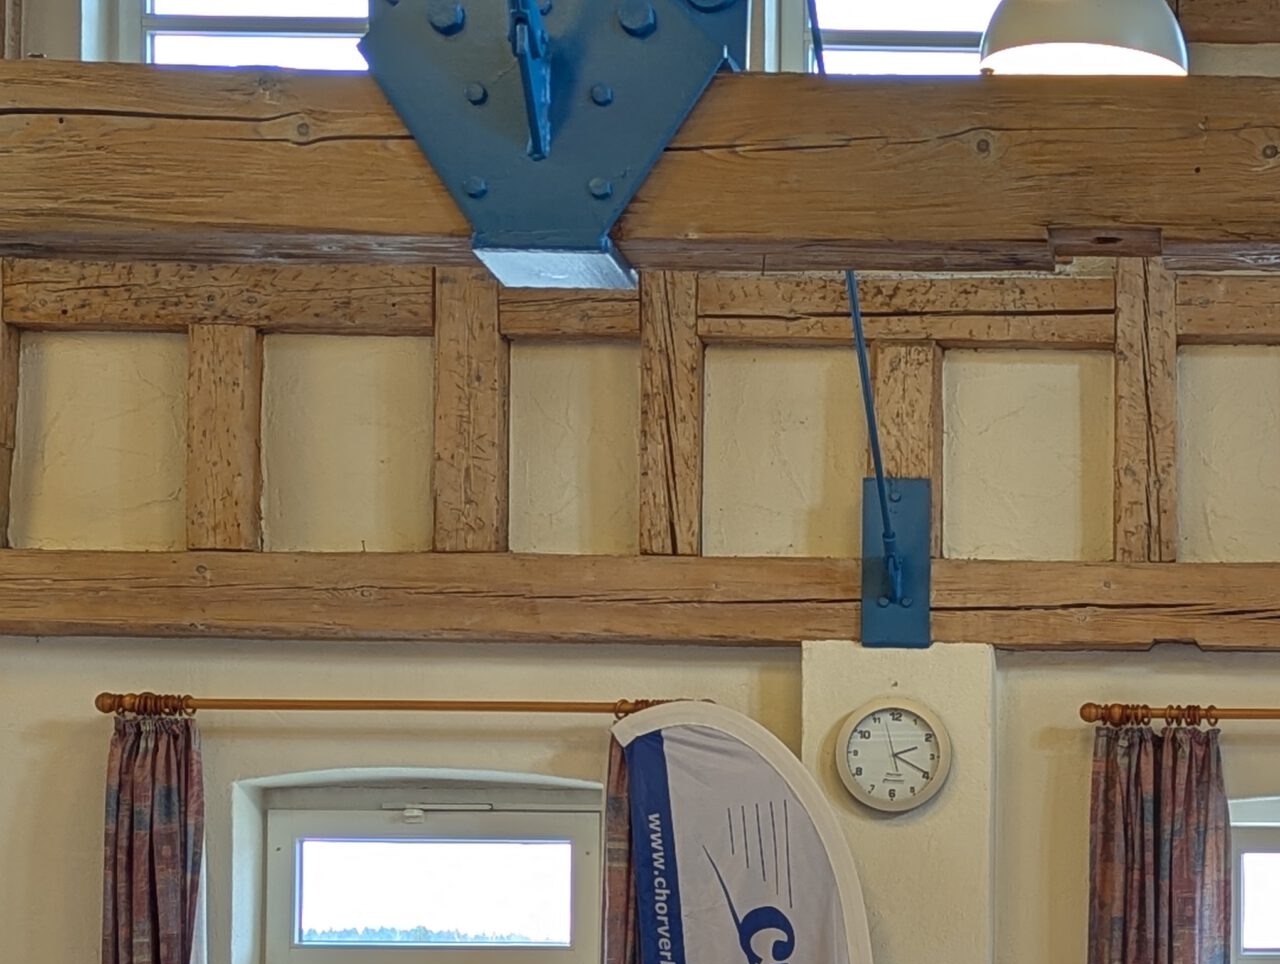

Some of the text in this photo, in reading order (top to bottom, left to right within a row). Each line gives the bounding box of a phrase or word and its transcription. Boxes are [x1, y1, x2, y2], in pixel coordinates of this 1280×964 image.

[889, 712, 903, 722] 12
[858, 730, 871, 739] 10
[924, 733, 932, 742] 2
[855, 767, 863, 776] 8
[888, 789, 896, 798] 6
